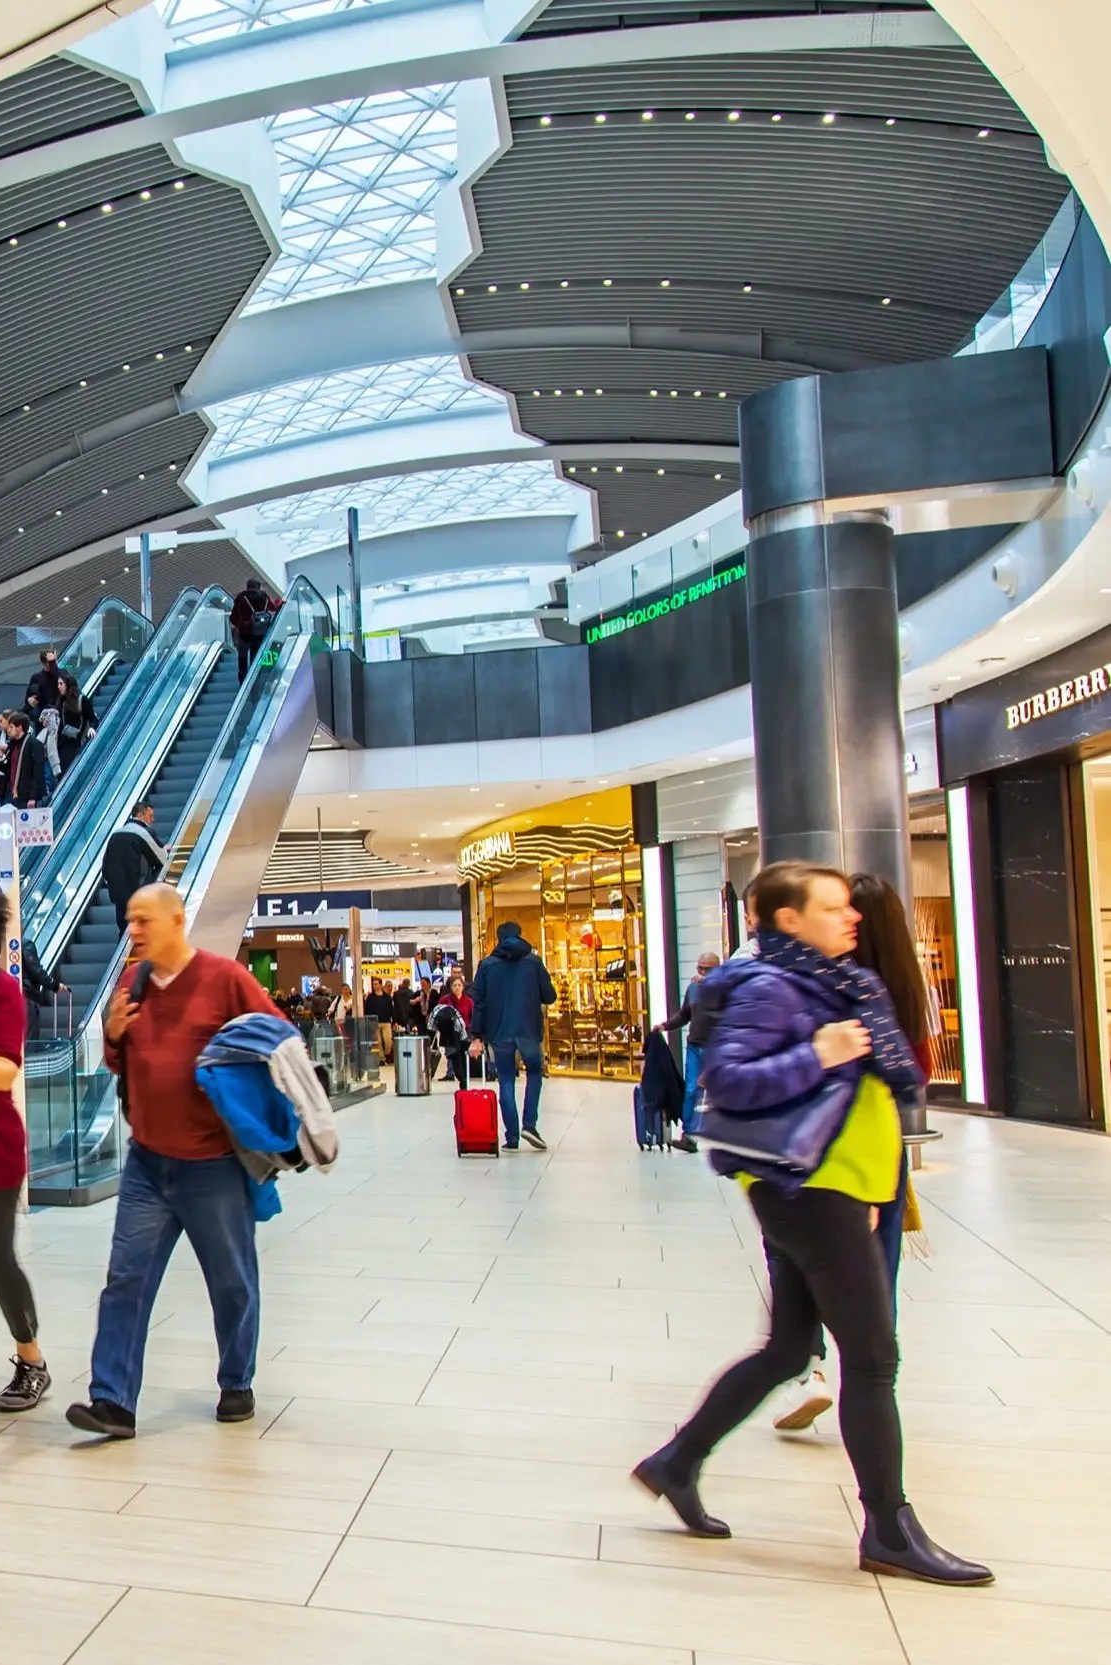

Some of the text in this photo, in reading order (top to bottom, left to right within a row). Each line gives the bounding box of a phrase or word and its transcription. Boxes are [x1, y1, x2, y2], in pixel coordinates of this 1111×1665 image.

[586, 616, 626, 645] UNITED
[626, 598, 670, 629] COLORS
[670, 590, 687, 610] OF
